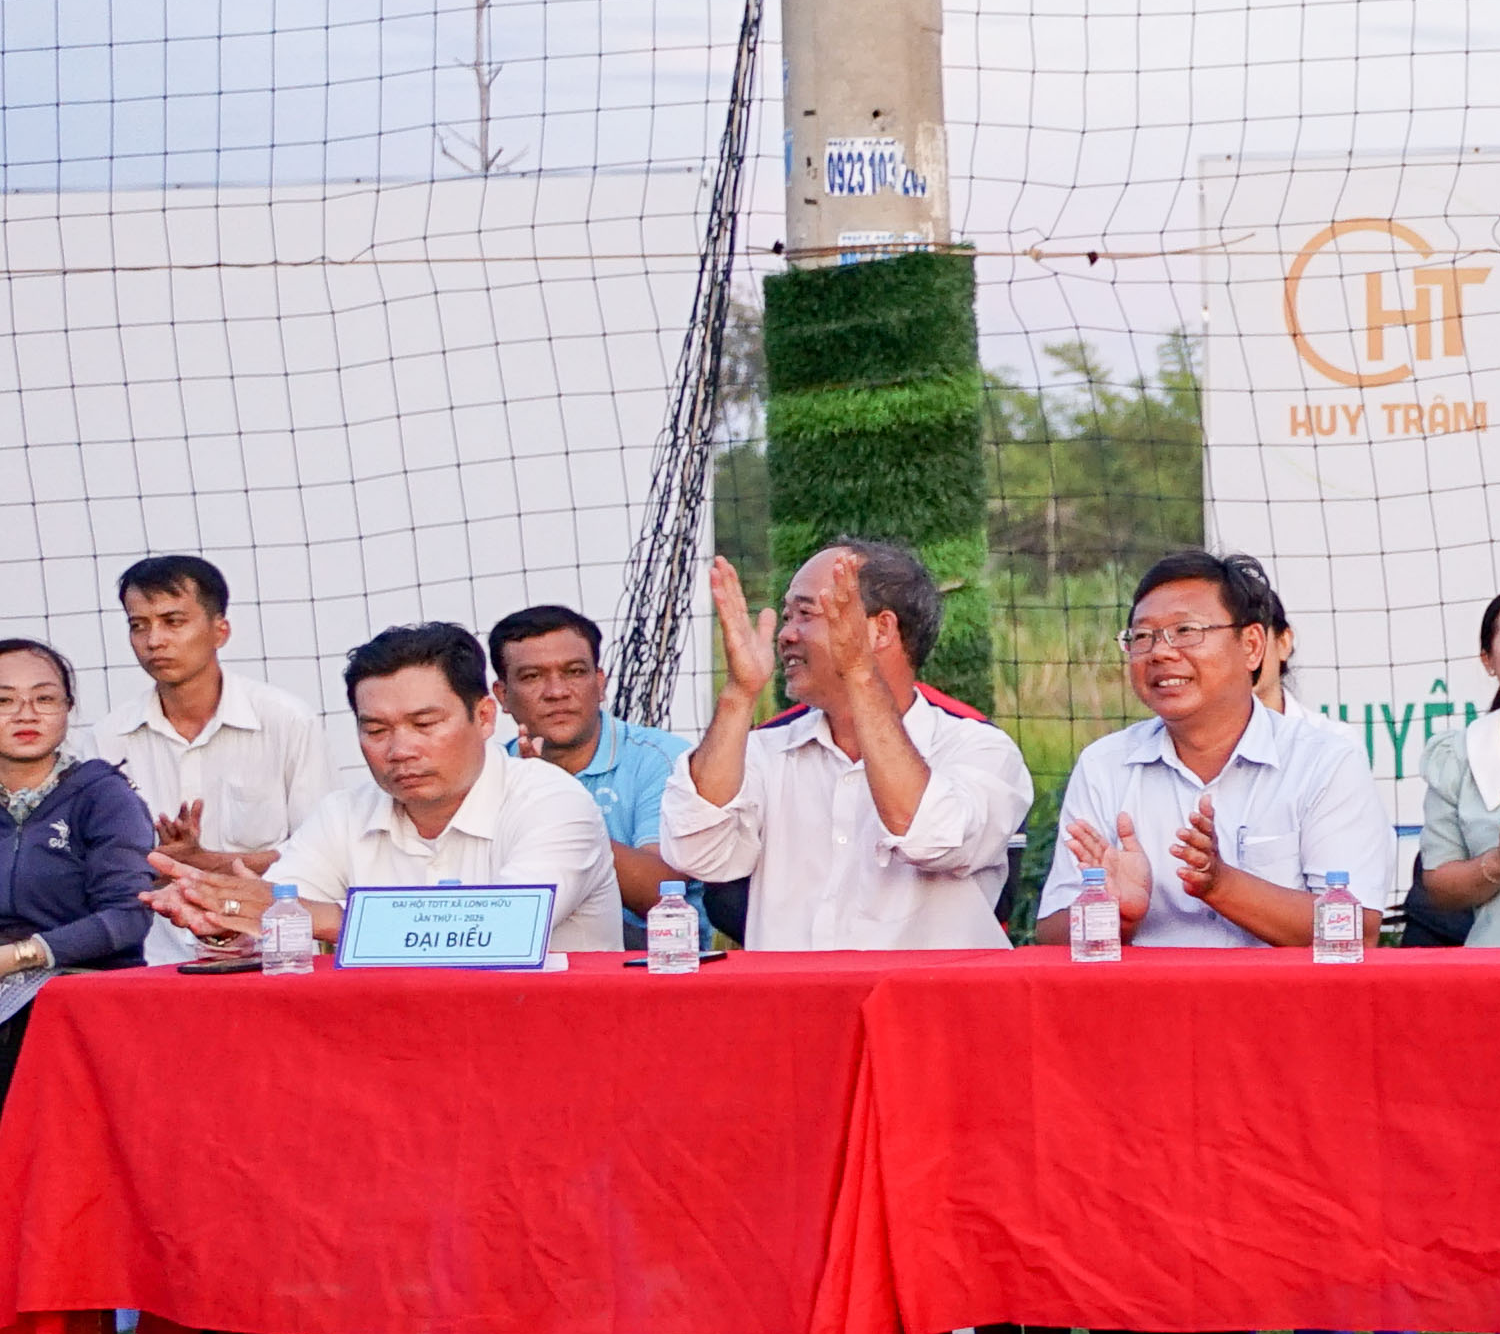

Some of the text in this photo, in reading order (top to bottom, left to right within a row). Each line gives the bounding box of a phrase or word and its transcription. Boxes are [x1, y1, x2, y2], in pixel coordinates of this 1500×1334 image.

[1289, 394, 1488, 437] HUY TRÂM
[404, 923, 493, 952] ĐẠI BIỂU
